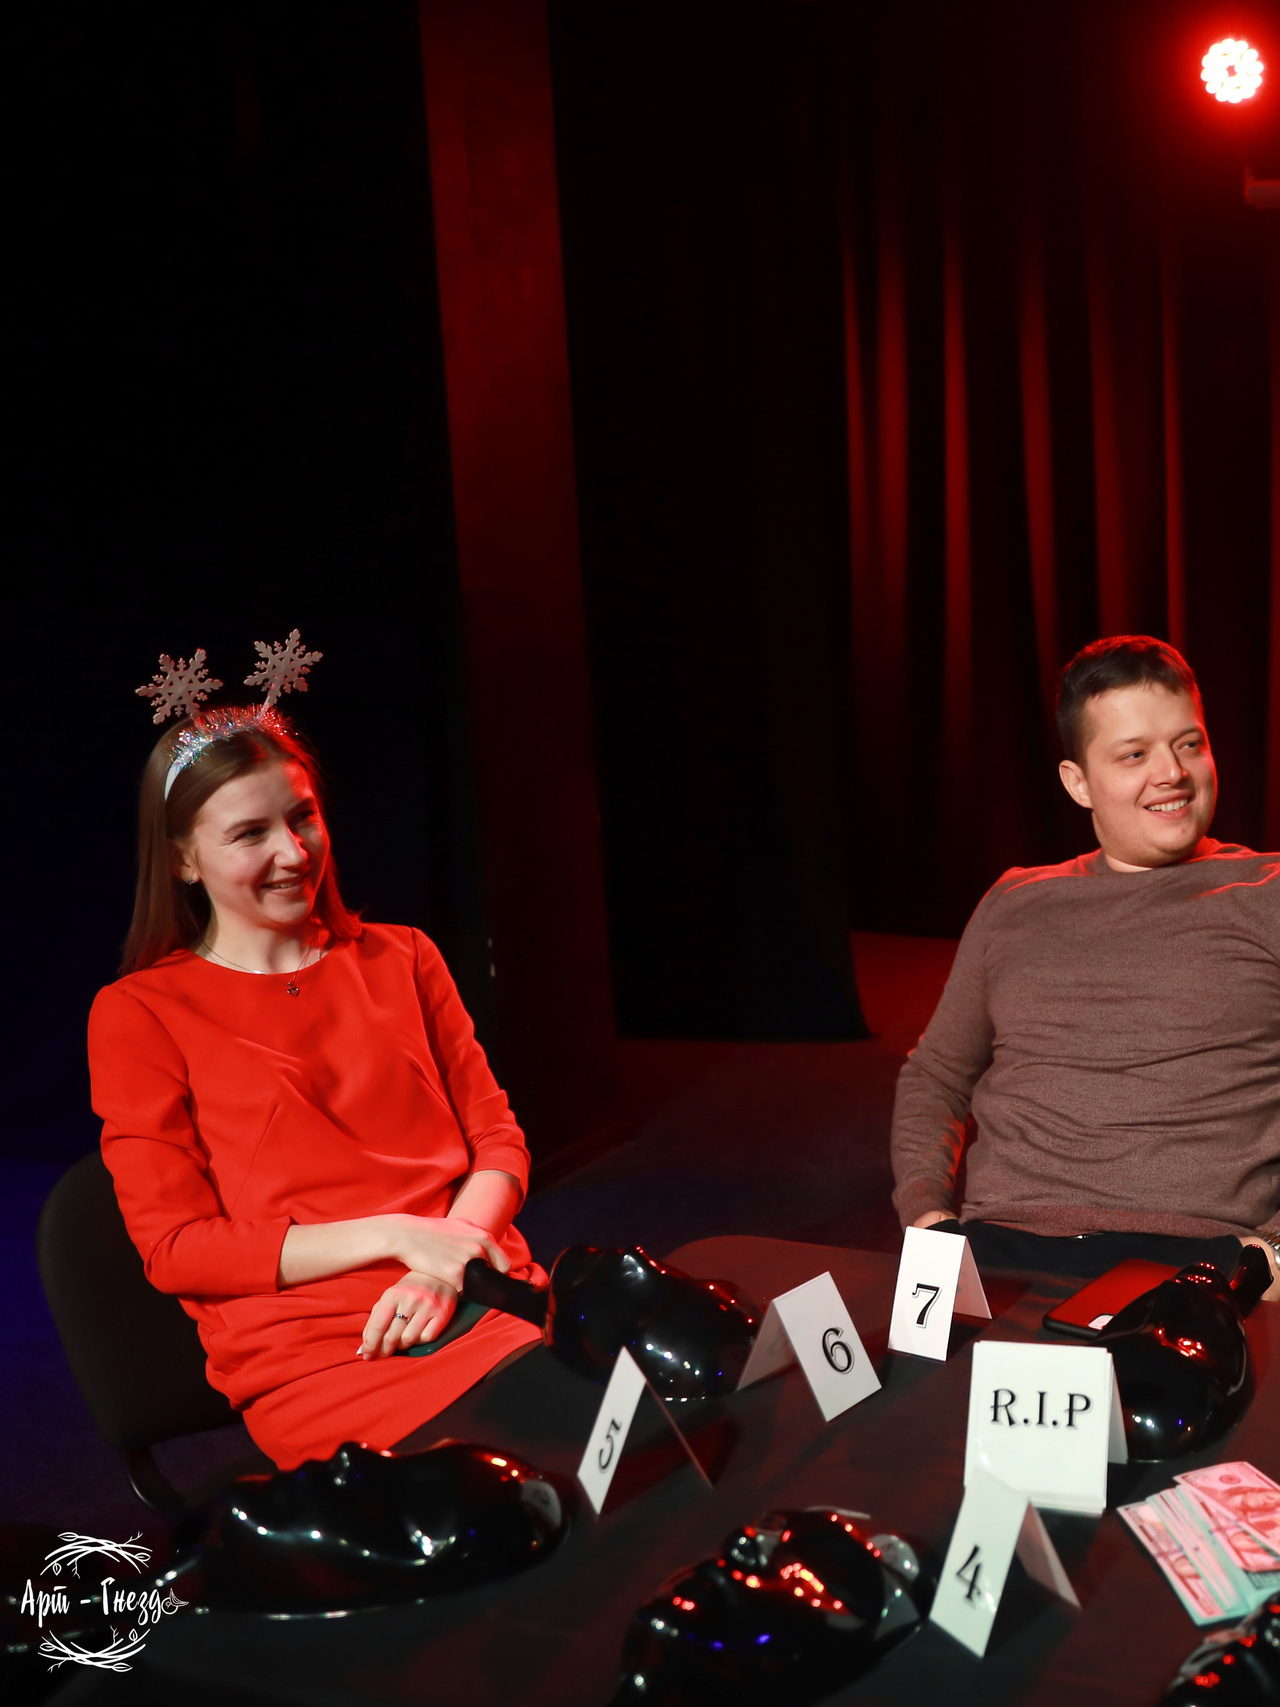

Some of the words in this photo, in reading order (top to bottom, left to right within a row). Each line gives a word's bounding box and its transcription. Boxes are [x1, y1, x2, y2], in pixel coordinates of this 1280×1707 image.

[912, 1283, 940, 1328] 7
[822, 1327, 855, 1375] 6
[990, 1388, 1094, 1430] R.I.P
[598, 1418, 622, 1471] 5
[956, 1545, 983, 1602] 4
